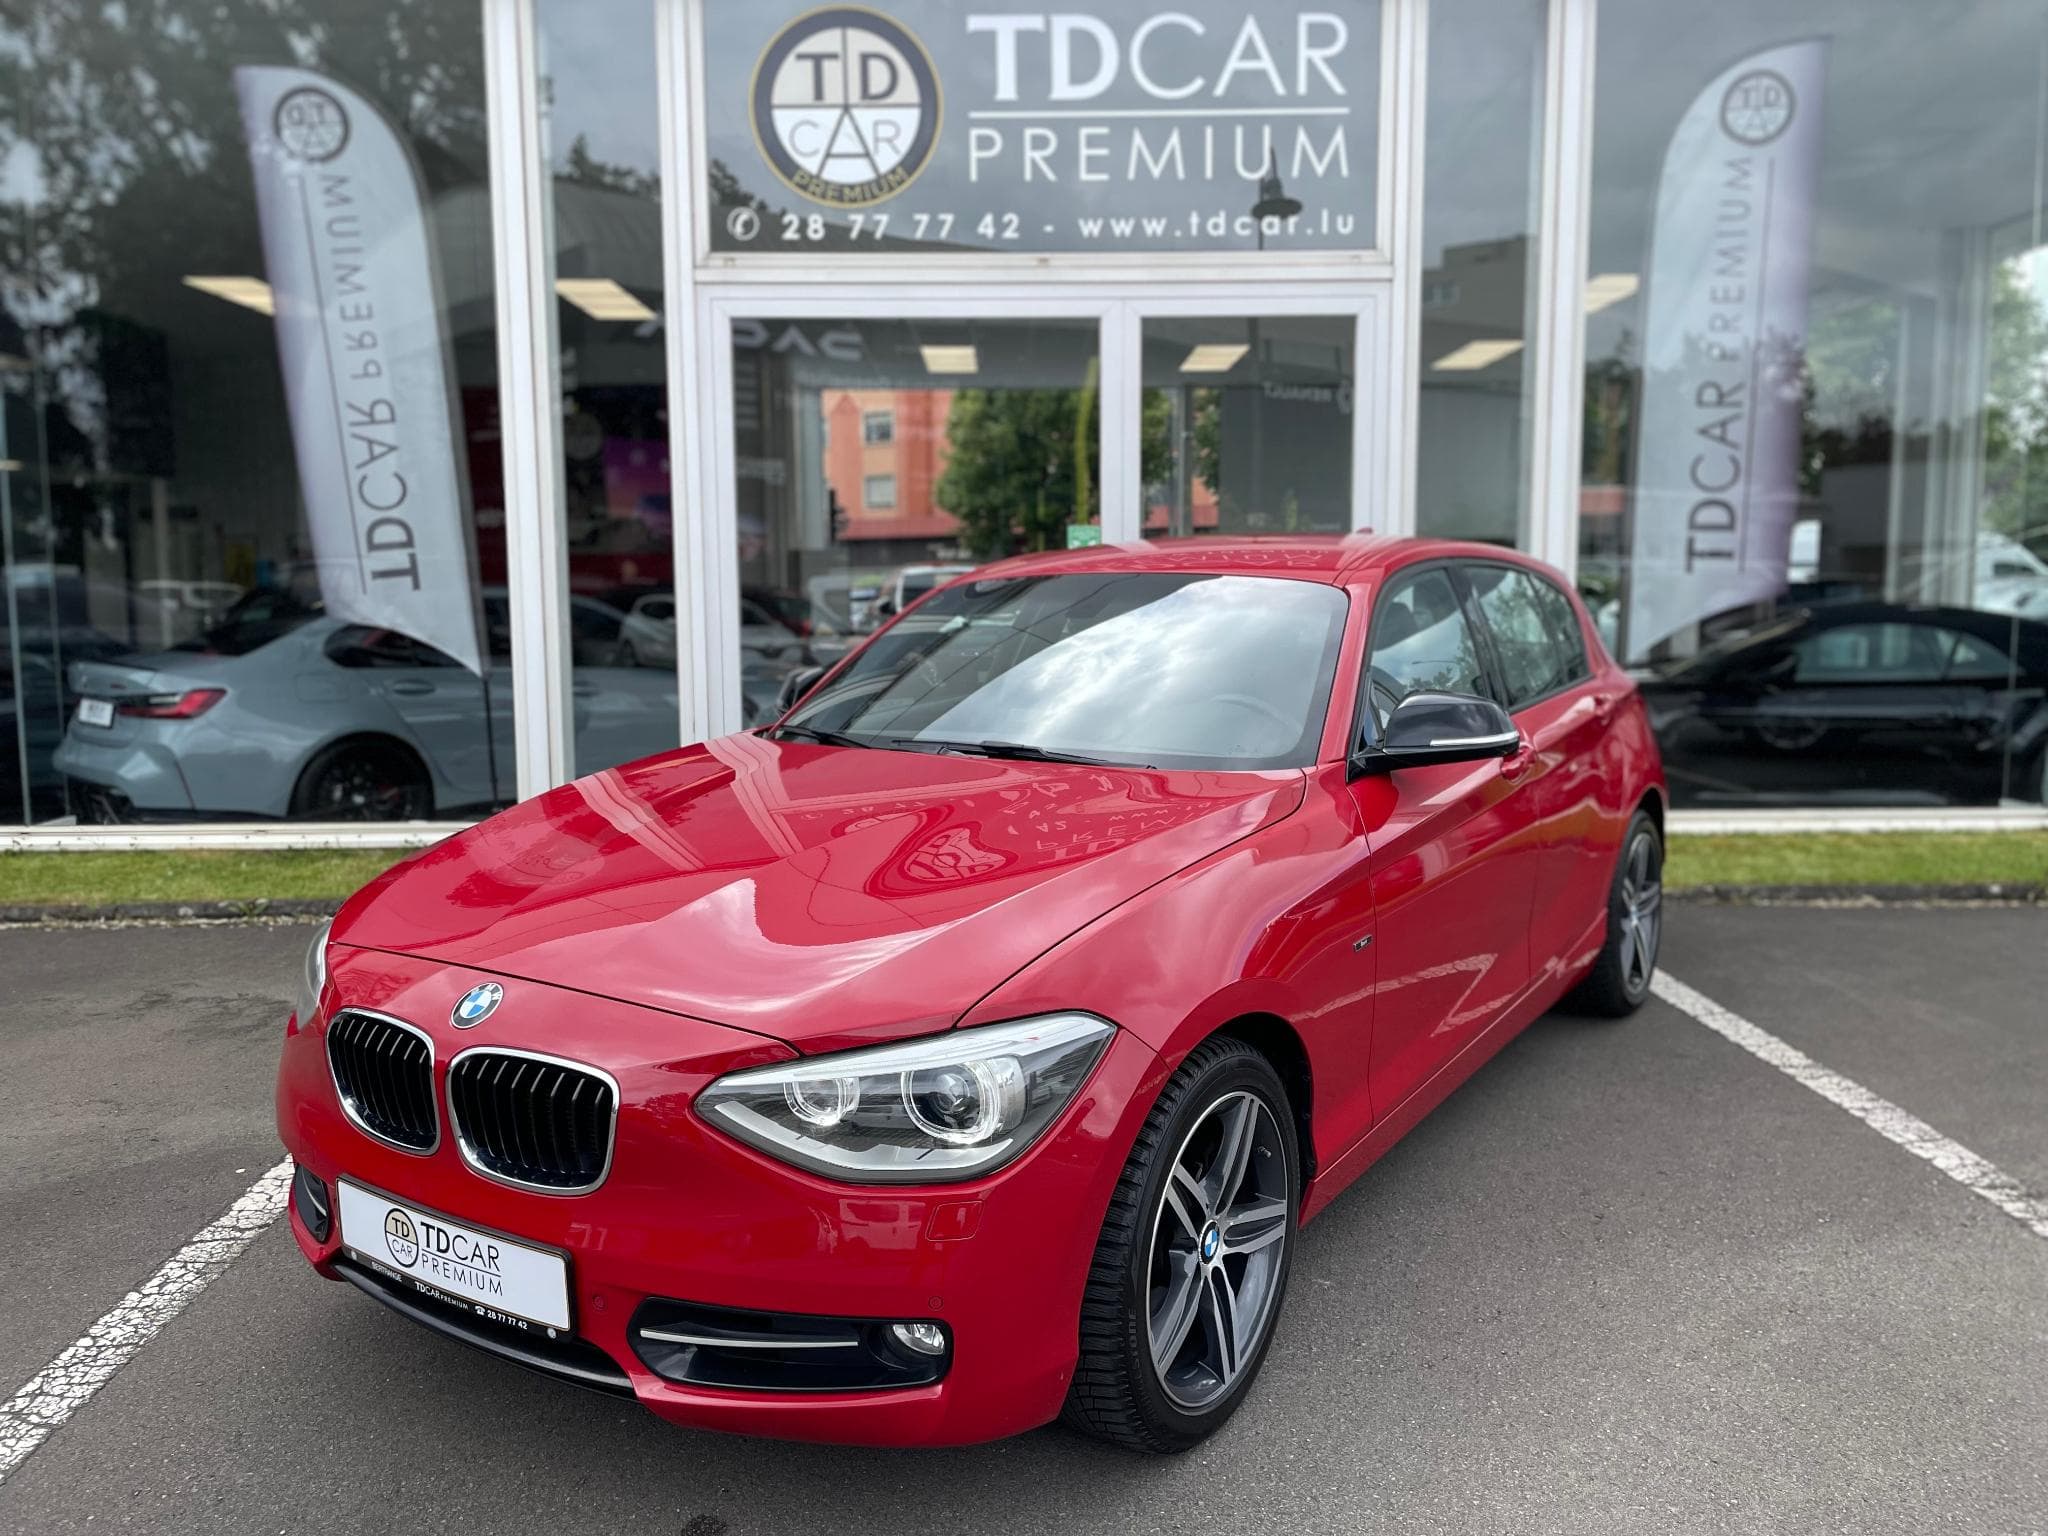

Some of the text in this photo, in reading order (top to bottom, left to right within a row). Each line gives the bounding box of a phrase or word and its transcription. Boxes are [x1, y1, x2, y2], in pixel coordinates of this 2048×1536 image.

[966, 13, 1348, 101] TDCAR
[968, 124, 1350, 182] PREMIUM
[790, 165, 911, 203] PREMIUM
[781, 212, 826, 241] 28
[847, 213, 891, 240] 77
[912, 213, 955, 240] 77
[975, 212, 1020, 239] 42
[1077, 208, 1355, 238] www.tdcar.lu
[1684, 157, 1752, 575] TDCAR PREMIUM
[391, 1216, 410, 1238] TD
[391, 1238, 413, 1260] CAR
[420, 1221, 501, 1272] TDCAR
[423, 1254, 502, 1296] PREMIUM
[414, 1281, 440, 1298] TDCAR
[441, 1295, 469, 1310] PREMIUM
[487, 1309, 497, 1320] 28
[517, 1320, 528, 1331] 42
